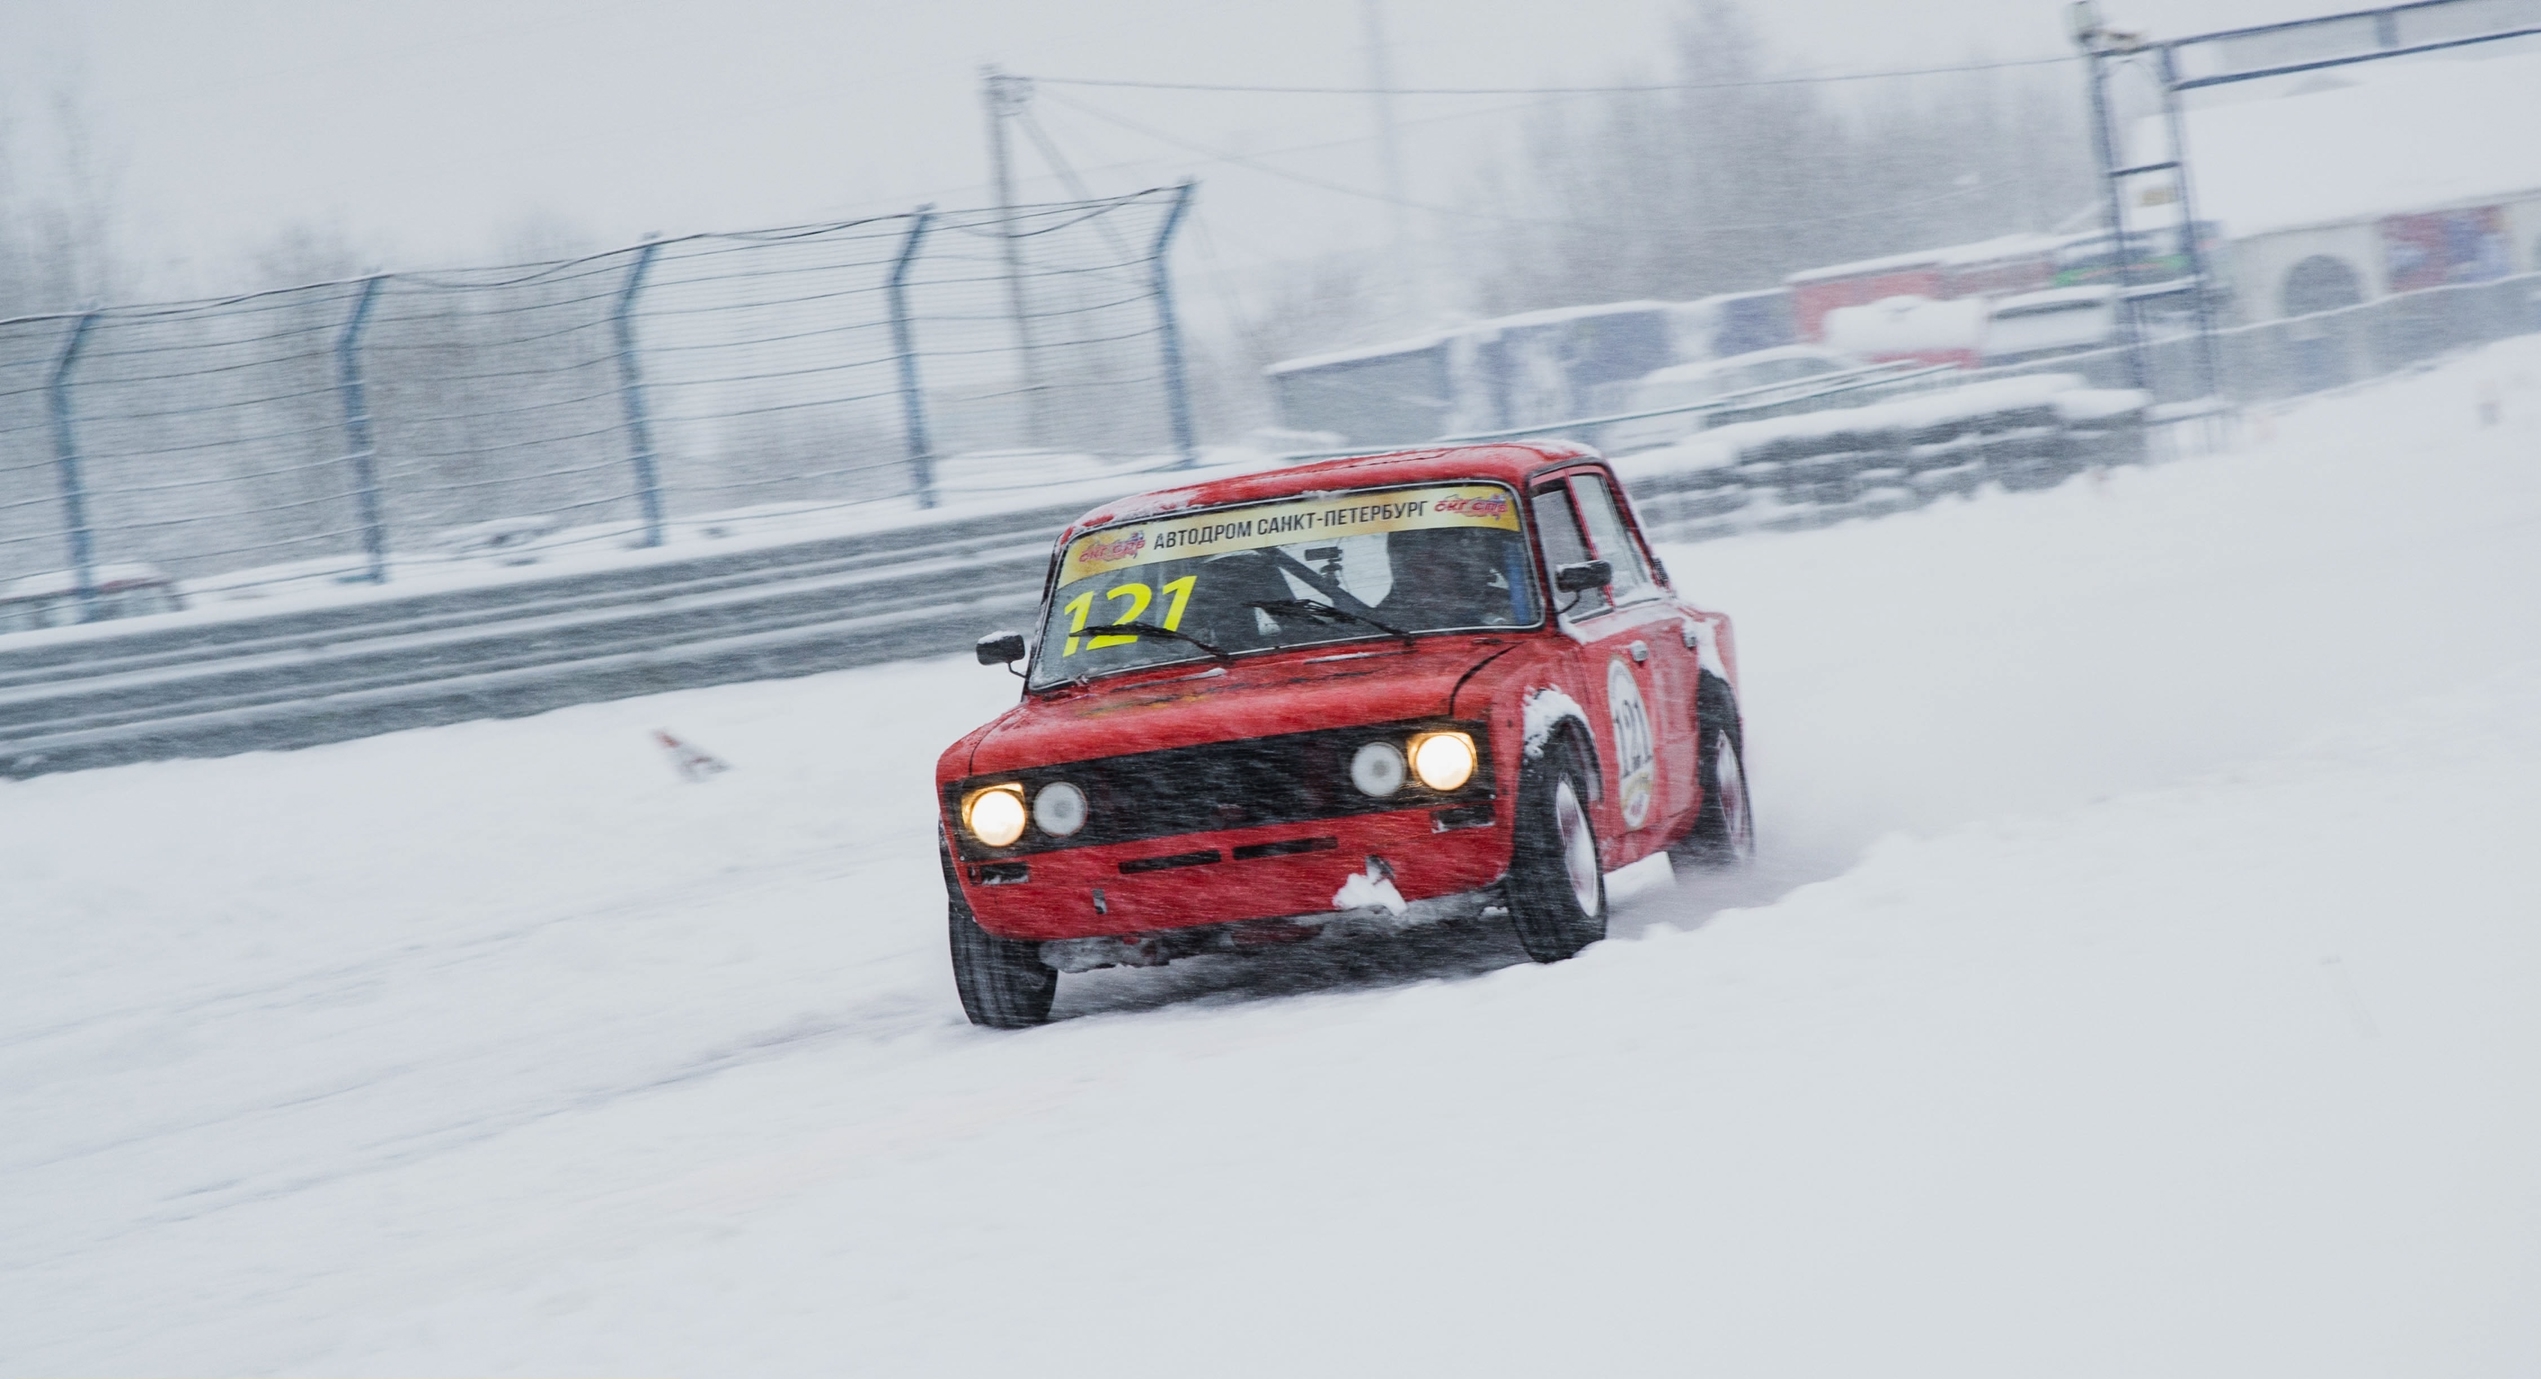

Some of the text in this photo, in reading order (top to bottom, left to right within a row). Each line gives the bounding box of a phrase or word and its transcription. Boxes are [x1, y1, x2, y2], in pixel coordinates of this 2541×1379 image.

[1153, 500, 1428, 550] АВТОДРОМ САНКТ-ПЕТЕРБУРГ
[1062, 575, 1197, 658] 121
[1613, 700, 1653, 779] 121
